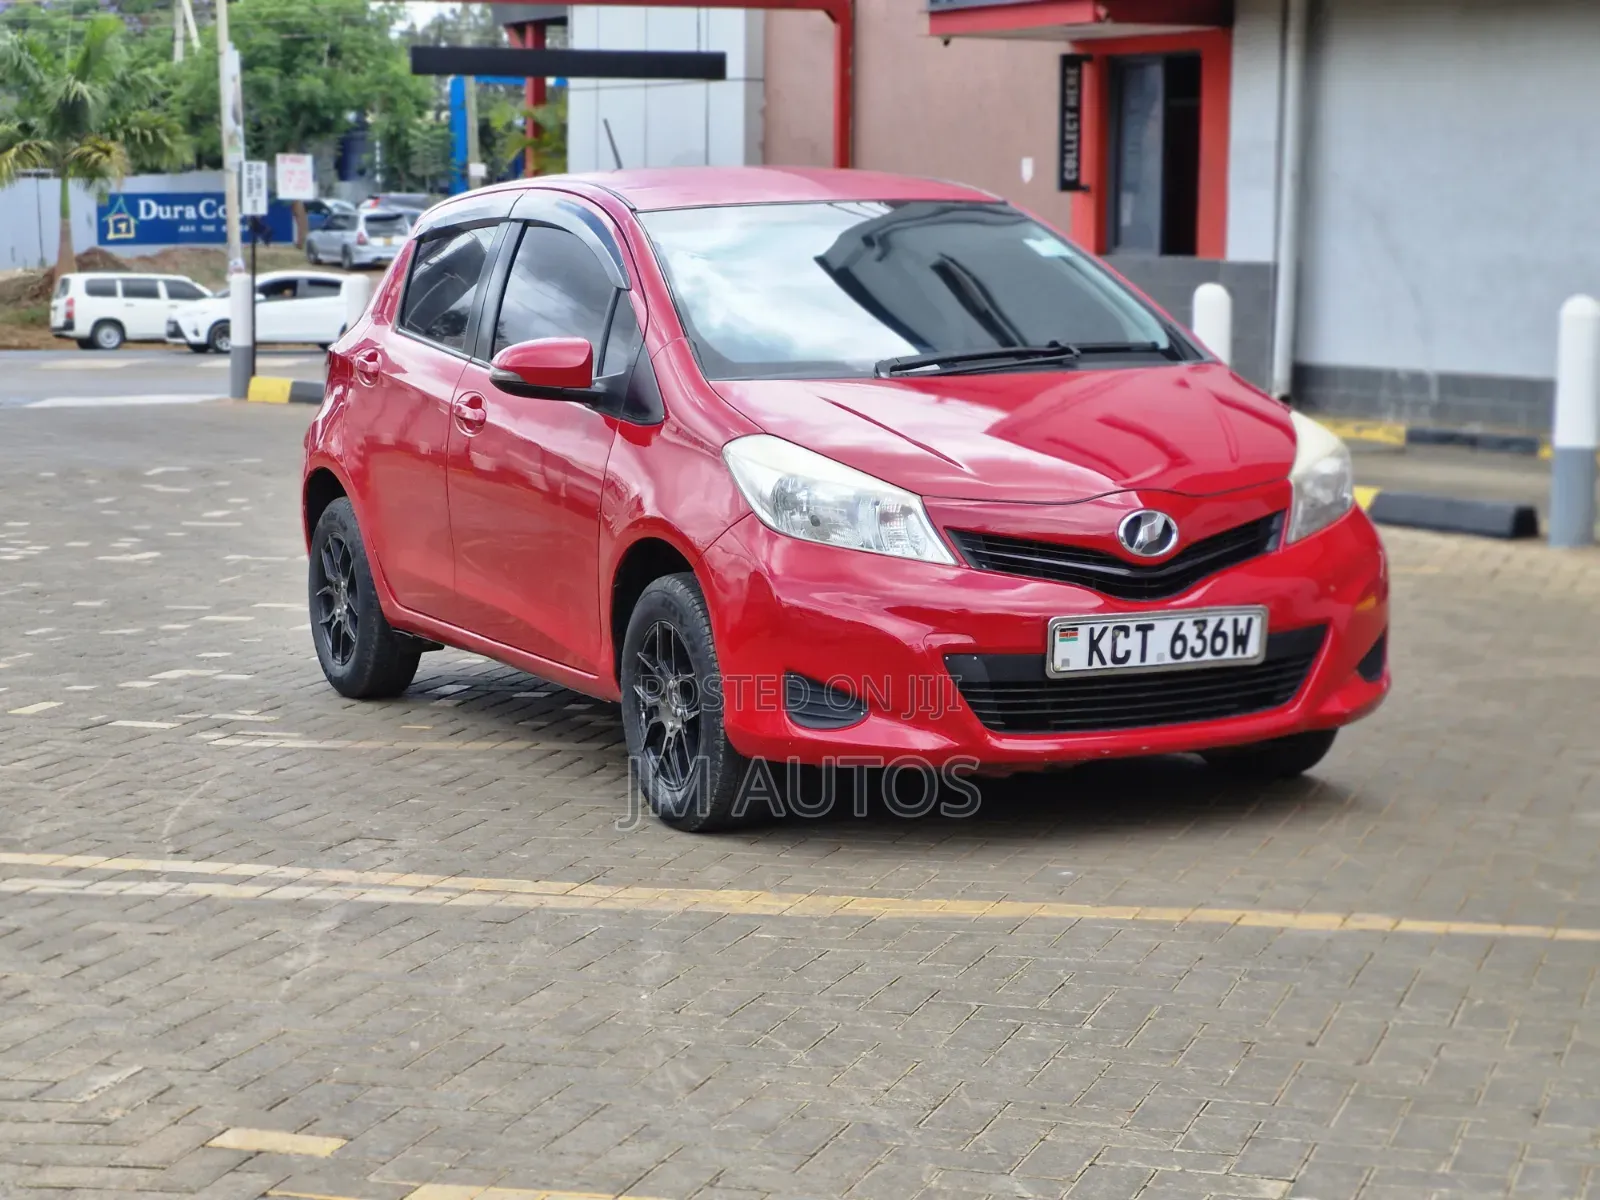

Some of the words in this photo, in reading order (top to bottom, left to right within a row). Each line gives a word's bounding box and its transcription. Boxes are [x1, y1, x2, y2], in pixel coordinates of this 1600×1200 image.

[1065, 65, 1079, 107] HERE
[1063, 111, 1079, 181] COLLECT
[138, 198, 242, 221] DuraCo
[1087, 623, 1156, 668] KCT
[1169, 616, 1254, 662] 636W
